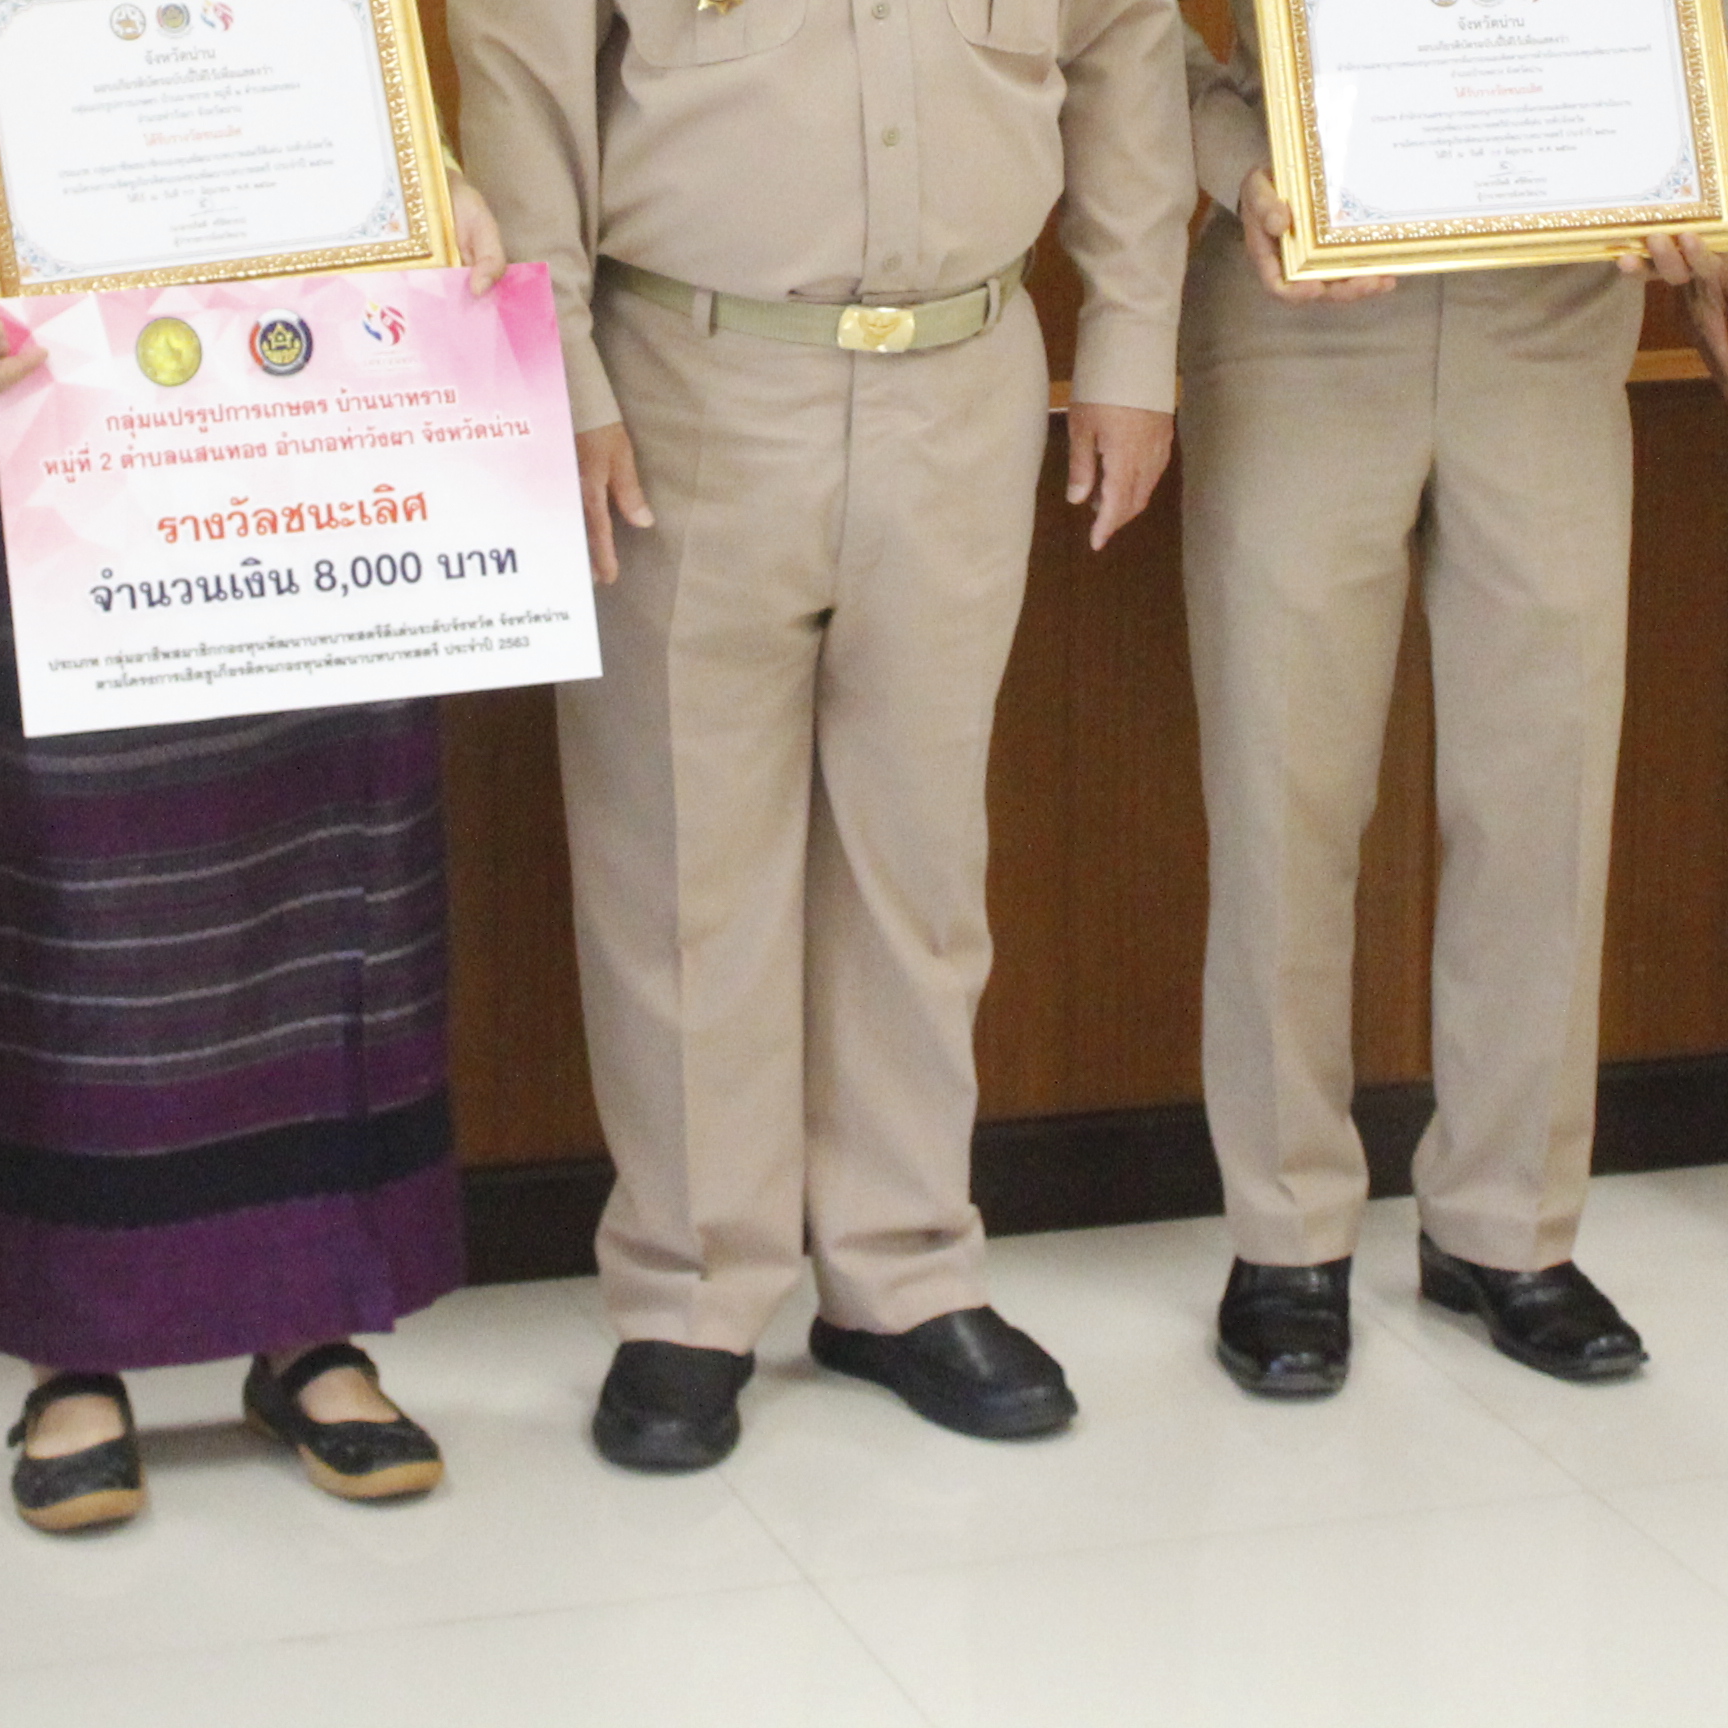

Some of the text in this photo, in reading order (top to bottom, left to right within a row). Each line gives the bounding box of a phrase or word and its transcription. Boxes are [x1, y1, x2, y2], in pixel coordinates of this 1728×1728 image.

[107, 388, 455, 438] กลุ่มแปรรูปการเกษตร บ้านนาทราย
[46, 417, 529, 483] หมู่ที่ 2 ตำบลแสนทอง อำเภอท่าวังผา จังหวัดน่าน
[157, 484, 428, 544] รางวัลชนะเลิศ
[90, 547, 518, 613] จำนวนเงิน 8,000 บาท
